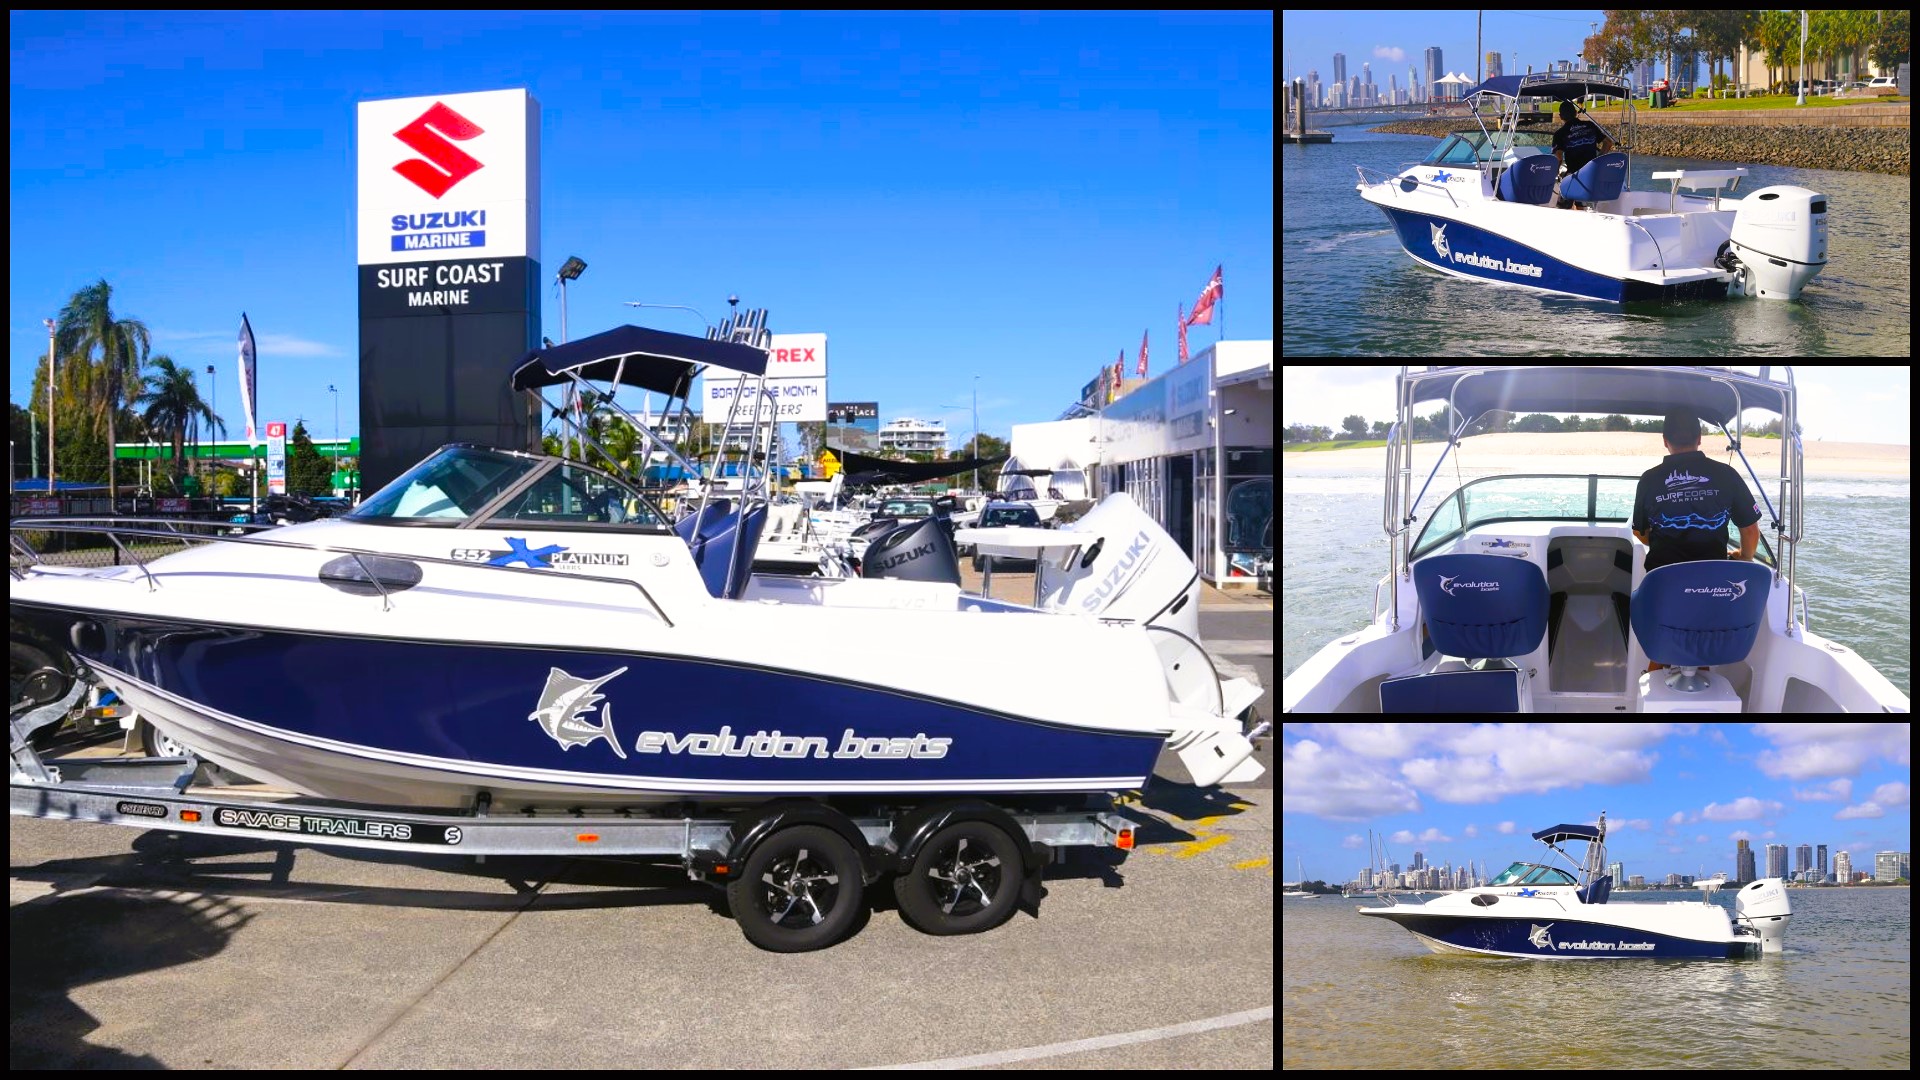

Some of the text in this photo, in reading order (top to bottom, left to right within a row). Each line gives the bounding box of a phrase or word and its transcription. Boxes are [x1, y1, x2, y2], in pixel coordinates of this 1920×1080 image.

[391, 210, 486, 231] SUZUKI
[405, 232, 471, 249] MARINE
[1455, 252, 1543, 277] evolution boats
[377, 263, 504, 288] SURF COAST
[408, 290, 469, 307] MARINE
[743, 386, 757, 398] OF
[761, 385, 779, 397] HE
[783, 385, 818, 397] MONTH
[729, 404, 803, 416] REETYLERS
[270, 425, 281, 433] 47
[453, 549, 491, 561] 552
[551, 553, 628, 566] PLATINUM
[873, 542, 937, 572] SUZUKI
[1082, 530, 1151, 613] SUZUKI
[636, 725, 953, 759] evolution boats
[220, 810, 300, 831] SAVAGE
[303, 817, 412, 840] TRAILERS
[1558, 940, 1656, 951] evolution boats
